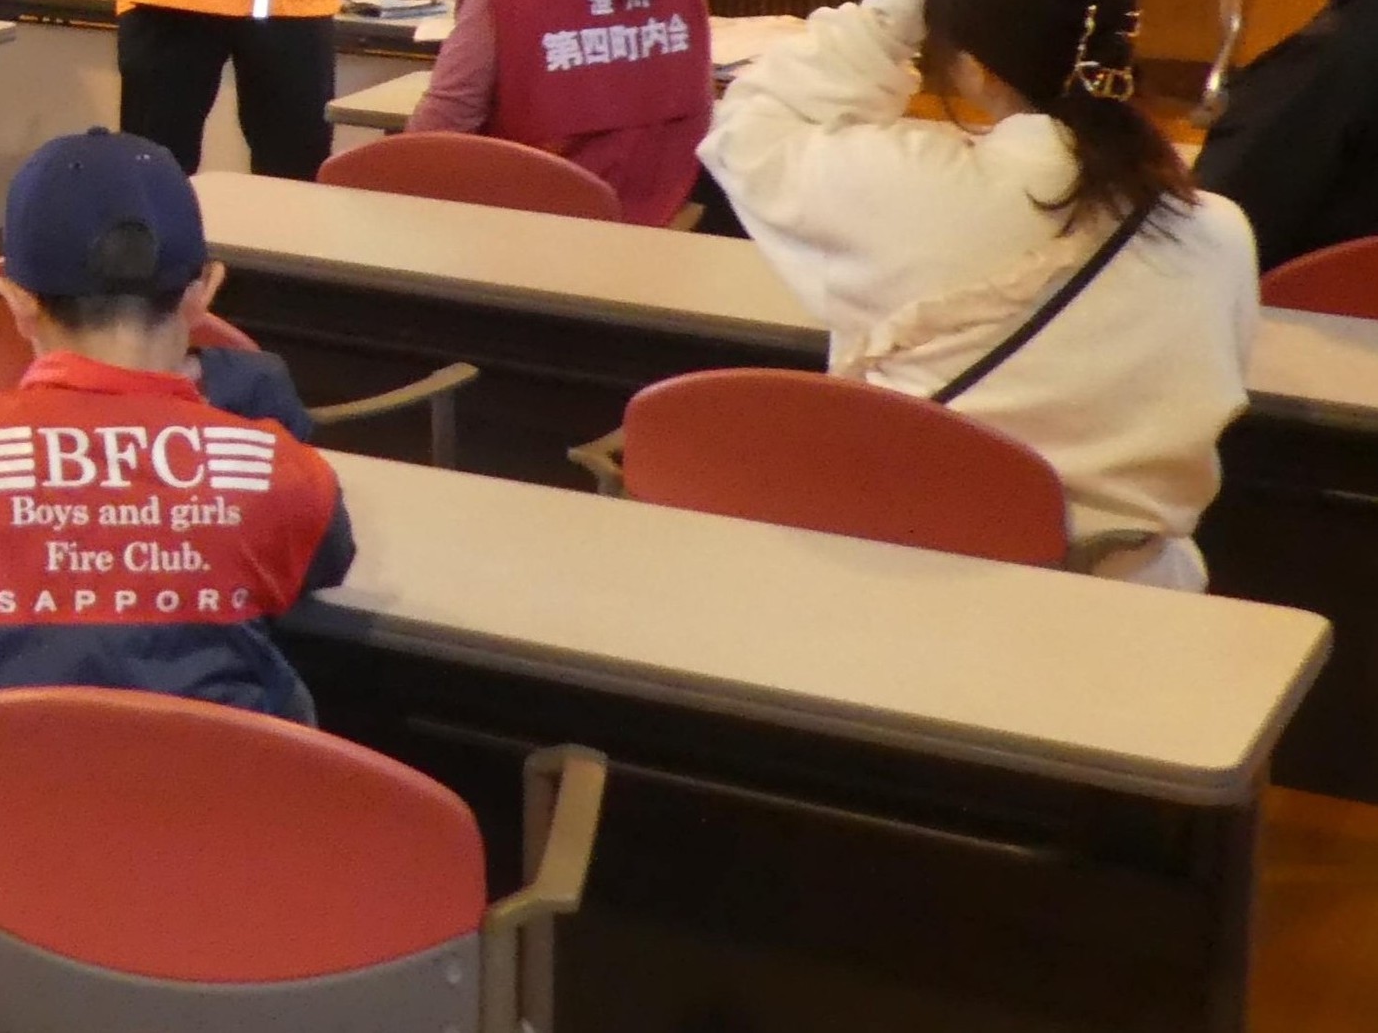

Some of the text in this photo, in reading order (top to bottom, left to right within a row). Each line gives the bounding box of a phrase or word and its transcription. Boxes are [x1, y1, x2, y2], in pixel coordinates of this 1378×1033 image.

[541, 13, 690, 72] 第四町内会
[37, 425, 205, 489] BFC
[10, 496, 242, 530] Boys and girls
[46, 540, 212, 572] Fire Club.
